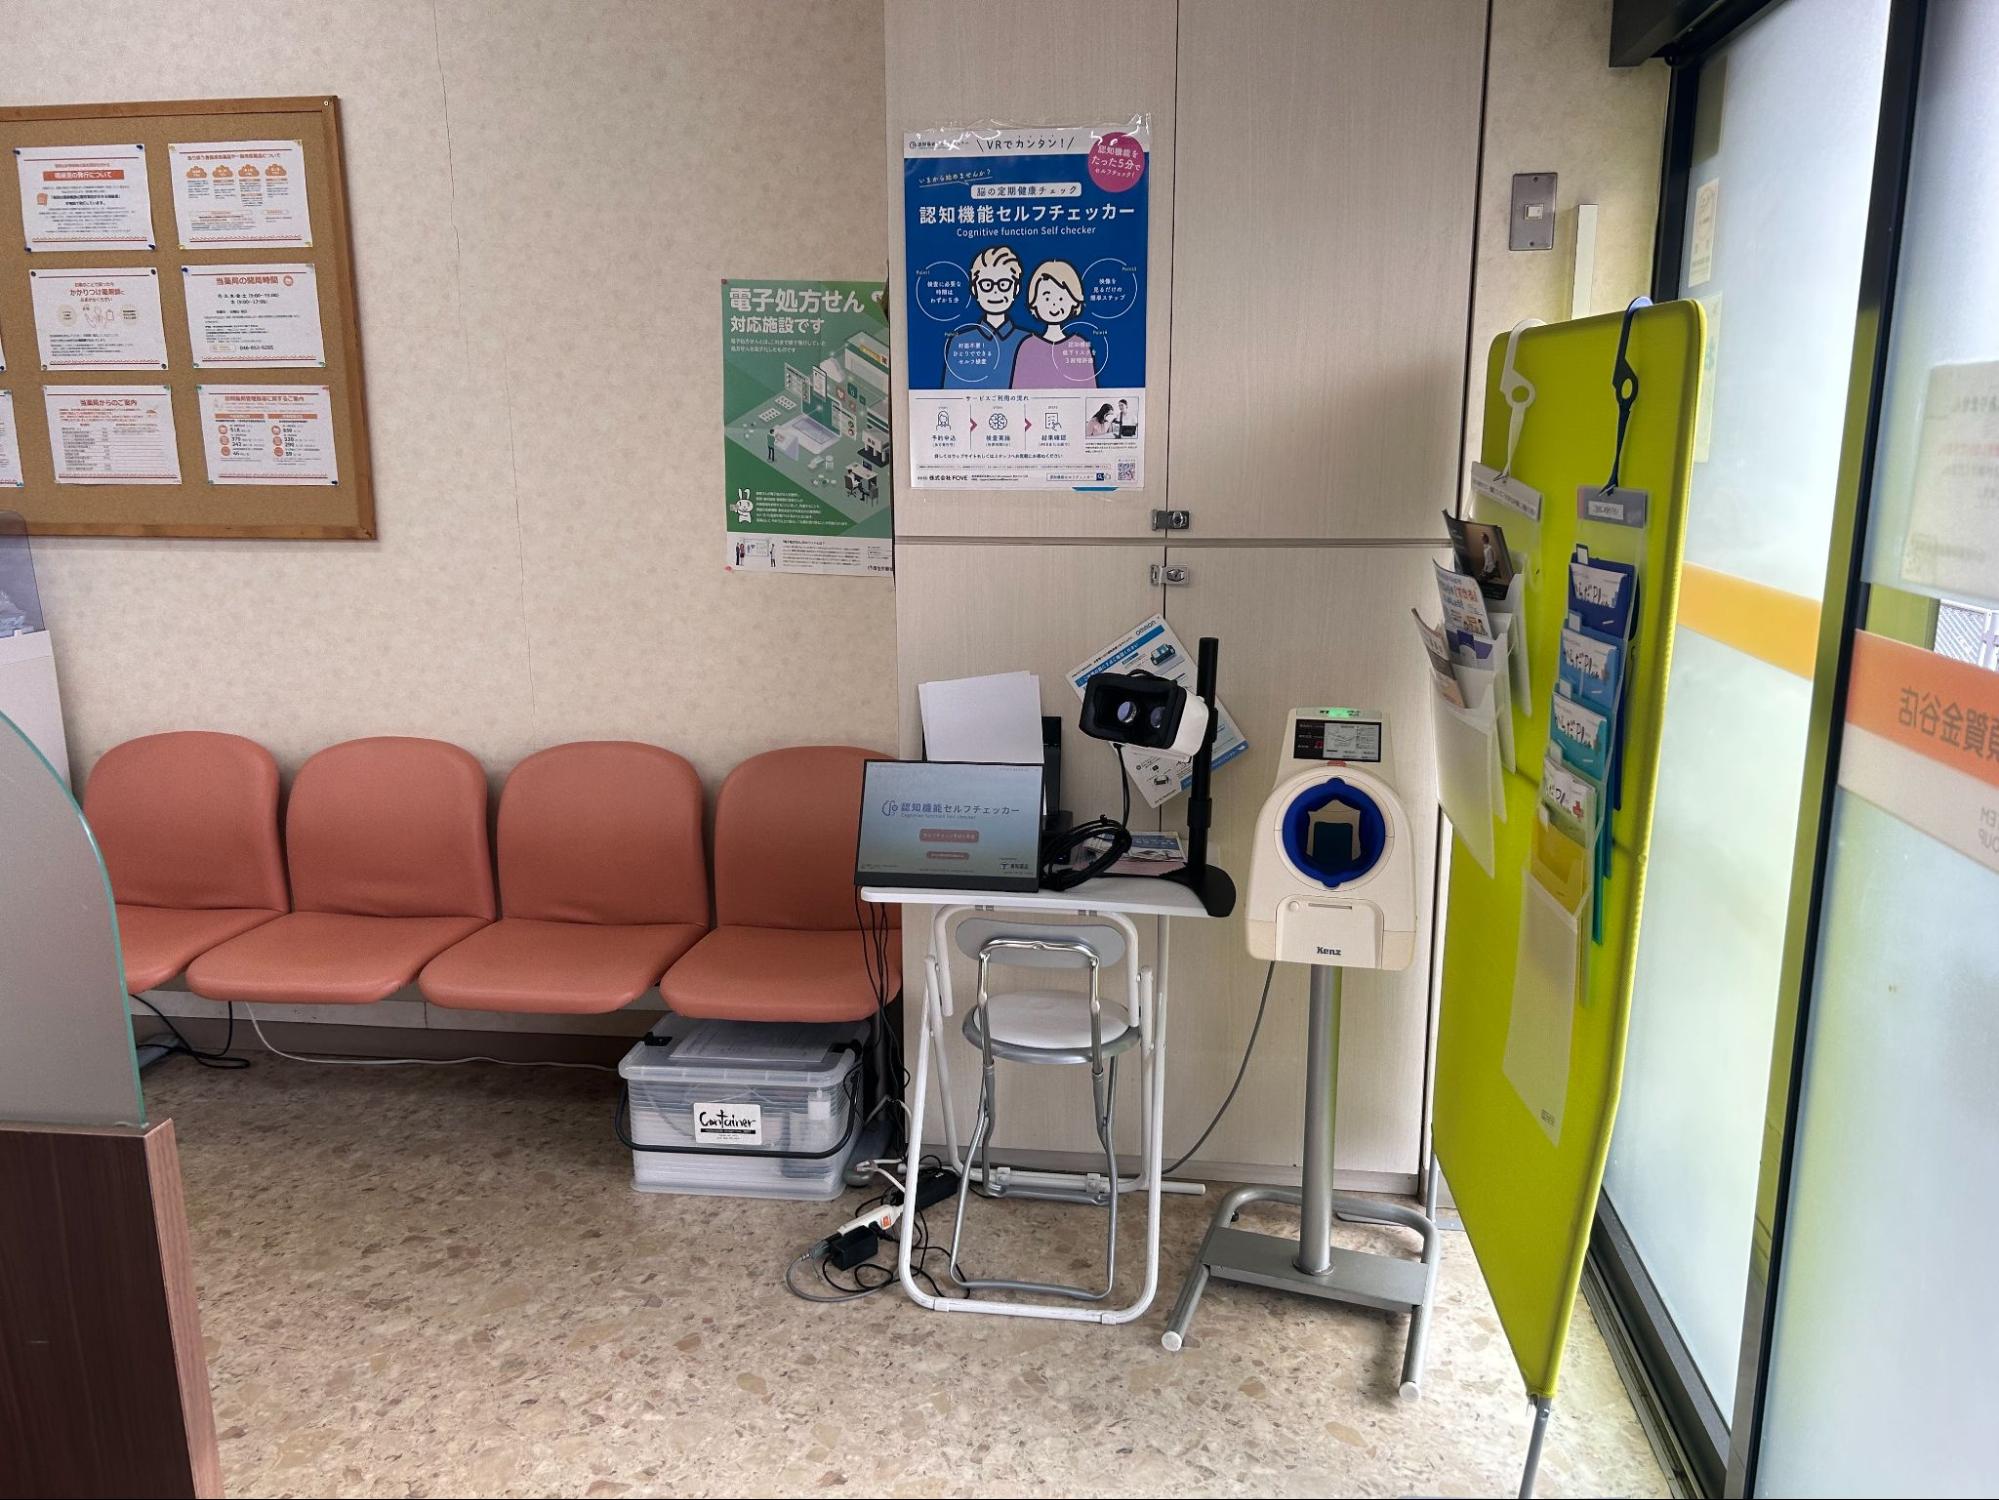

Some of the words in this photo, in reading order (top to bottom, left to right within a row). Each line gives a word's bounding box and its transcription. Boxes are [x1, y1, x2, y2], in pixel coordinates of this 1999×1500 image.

[1091, 155, 1141, 171] たった5分で
[975, 184, 1078, 197] 脳の定期健康チェック
[919, 203, 1136, 225] 認知機能セルフチェッカー
[956, 227, 999, 239] Cognitive
[1000, 226, 1039, 237] function
[1041, 226, 1059, 236] Self
[1060, 225, 1096, 236] checker
[729, 287, 865, 314] 電子処方せん
[730, 315, 825, 335] 対応施設です
[900, 801, 1020, 816] 認知機能セルフチェッカー
[1316, 946, 1342, 956] Kenz
[699, 1109, 757, 1128] Container
